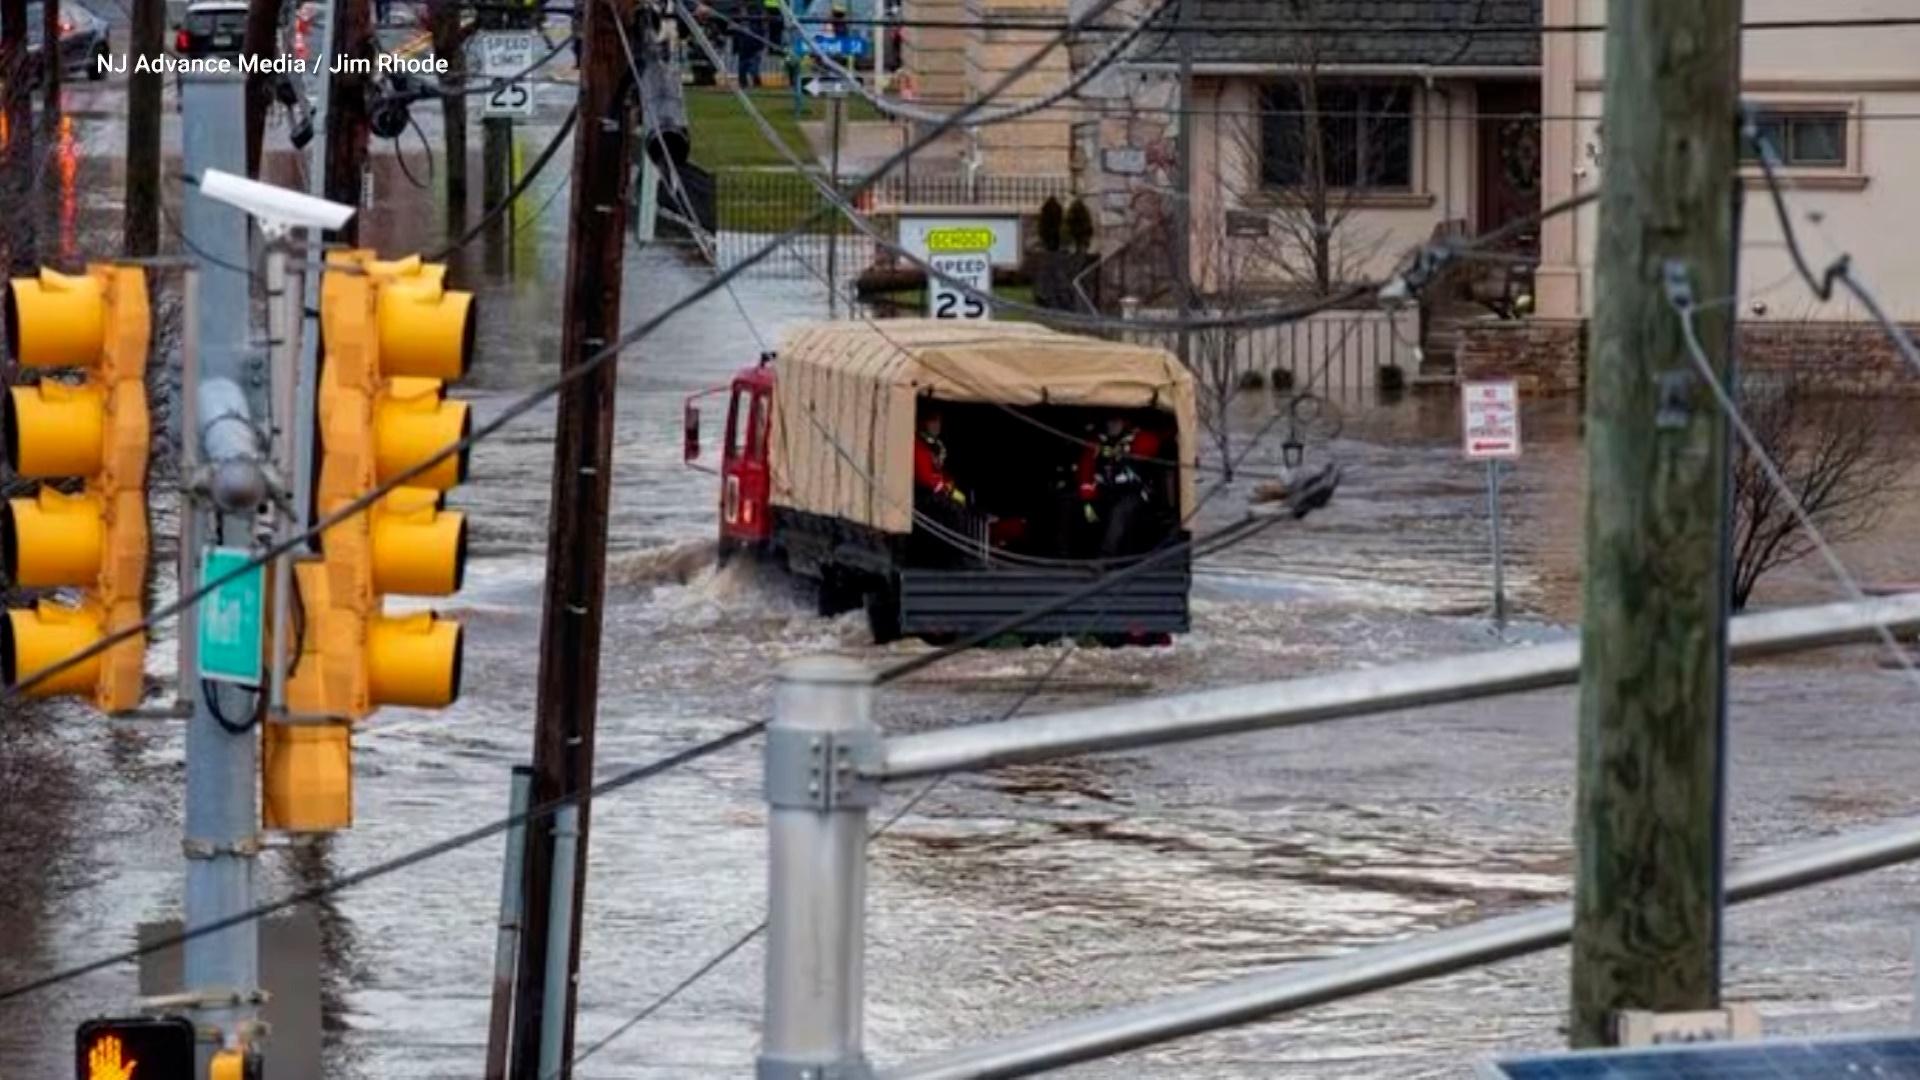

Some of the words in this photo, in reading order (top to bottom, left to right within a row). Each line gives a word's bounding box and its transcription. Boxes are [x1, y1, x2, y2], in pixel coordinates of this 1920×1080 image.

[486, 36, 529, 50] SPEED
[491, 77, 528, 107] 25
[931, 231, 986, 249] SCHOOL
[934, 260, 986, 273] SPEED
[936, 293, 984, 318] 25
